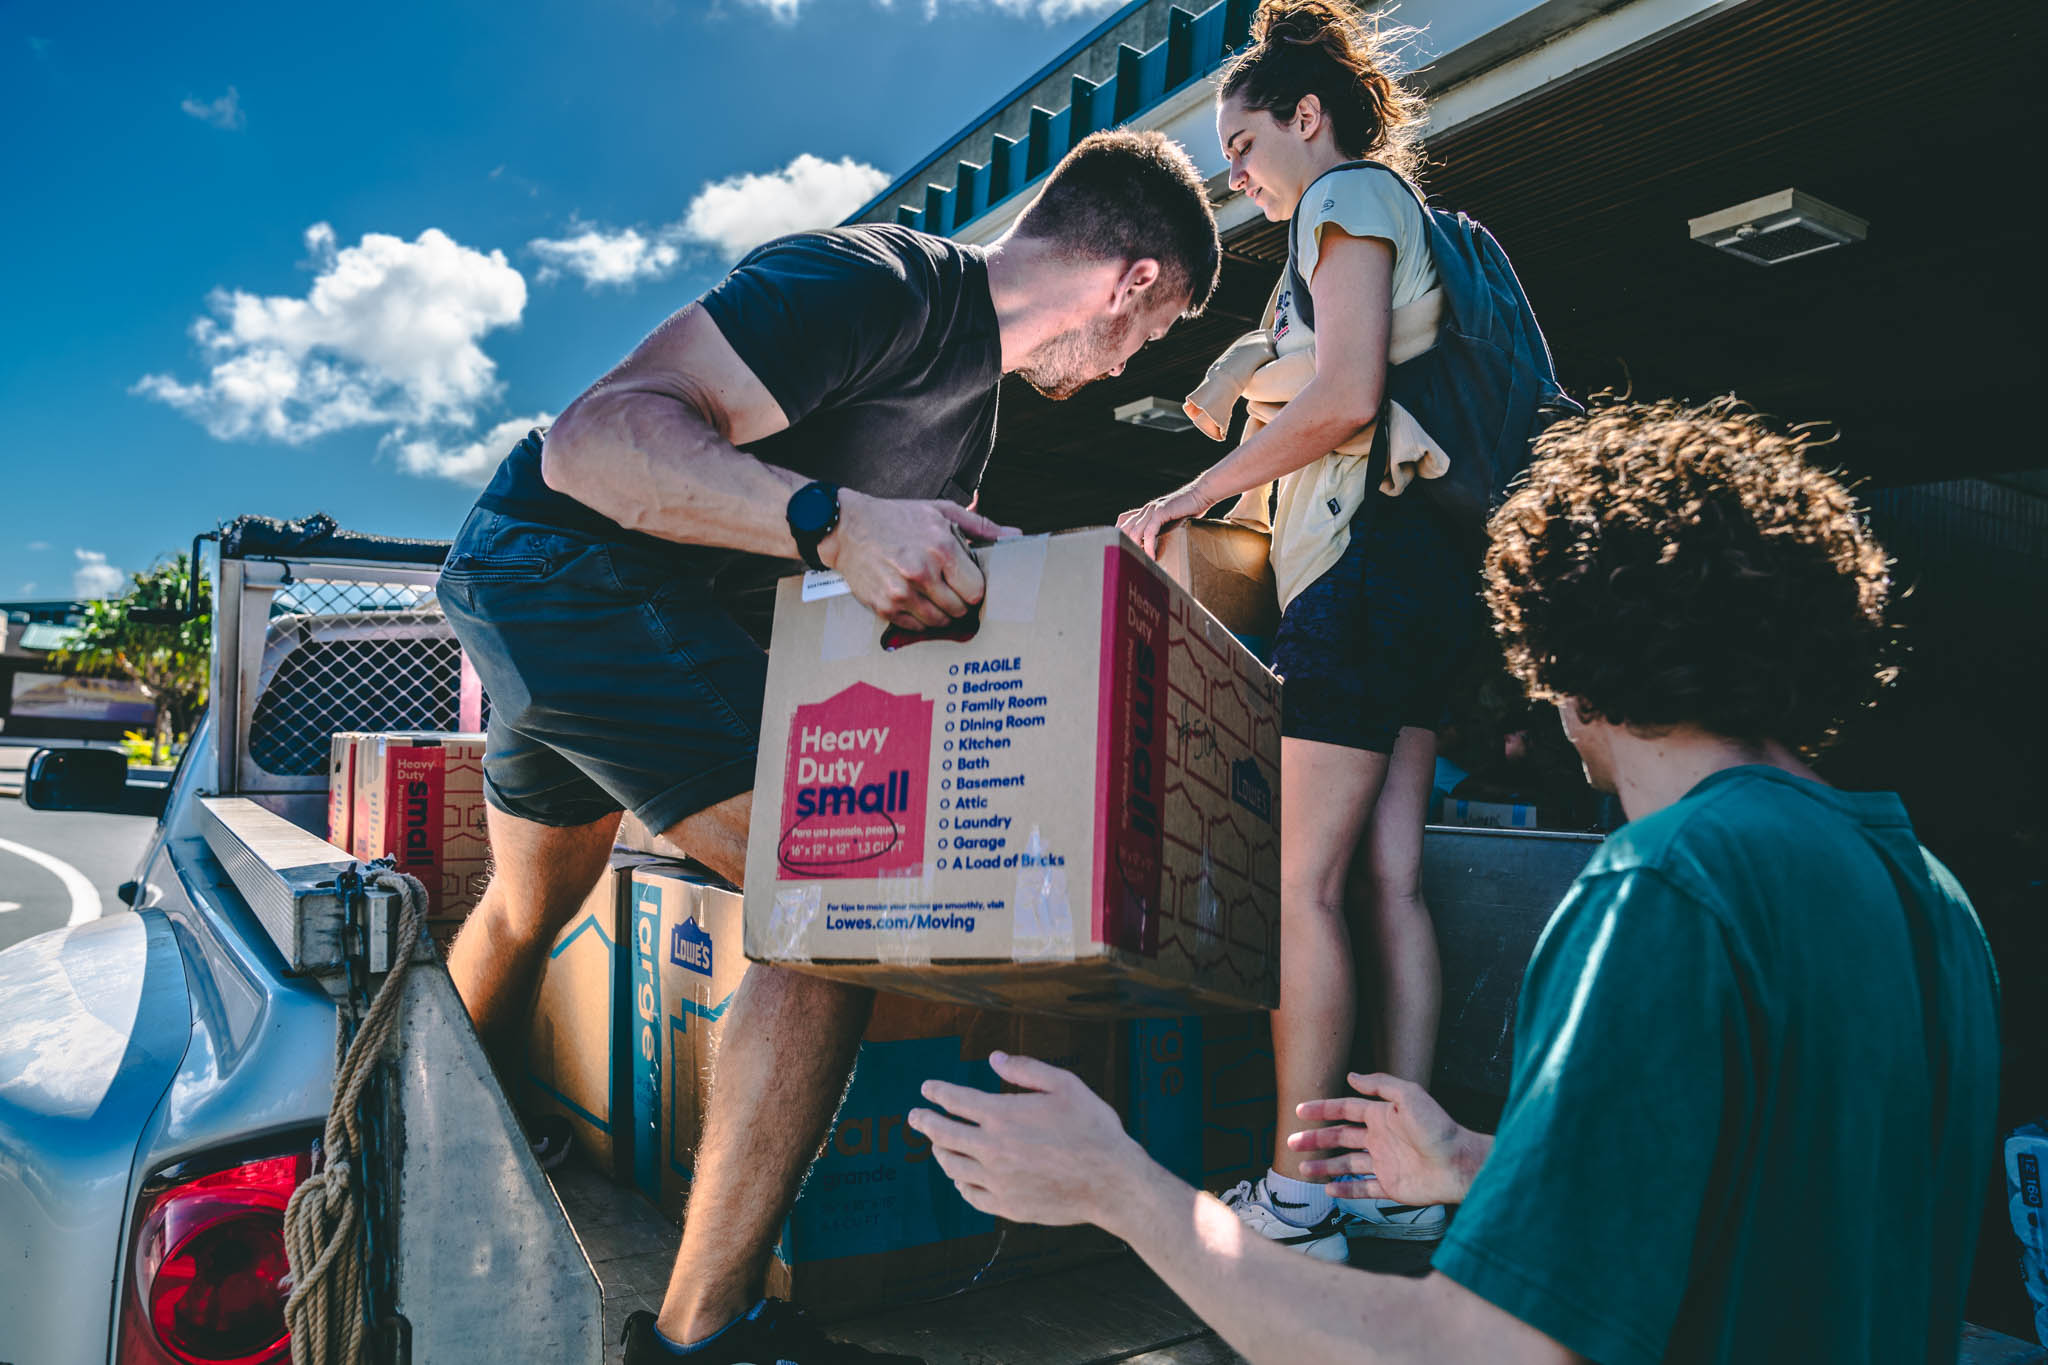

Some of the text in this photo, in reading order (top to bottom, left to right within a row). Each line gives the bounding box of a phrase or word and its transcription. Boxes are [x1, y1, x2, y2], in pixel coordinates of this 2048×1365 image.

[1128, 580, 1160, 627] Heavy
[1128, 605, 1153, 643] Duty
[964, 657, 1021, 675] FRAGILE
[962, 679, 1023, 694] Bedroom
[961, 696, 1047, 713] Family Room
[960, 715, 1045, 732] Dining Room
[801, 726, 889, 754] Heavy
[959, 736, 1011, 751] Kitchen
[1131, 637, 1156, 838] small
[397, 759, 434, 773] Heavy
[798, 757, 864, 786] Duty
[957, 756, 990, 771] Bath
[397, 770, 425, 782] Duty
[956, 774, 1024, 790] Basement
[796, 770, 909, 817] small
[955, 795, 988, 809] Attic
[407, 781, 434, 865] small
[954, 814, 1011, 830] Laundry
[953, 836, 1006, 851] Garage
[952, 856, 962, 870] A
[965, 854, 1001, 869] Load
[1003, 853, 1018, 868] of
[826, 912, 975, 933] Lowes.com/Moving
[674, 933, 711, 971] LOWE'S
[638, 900, 658, 1062] large
[823, 1163, 897, 1191] grande
